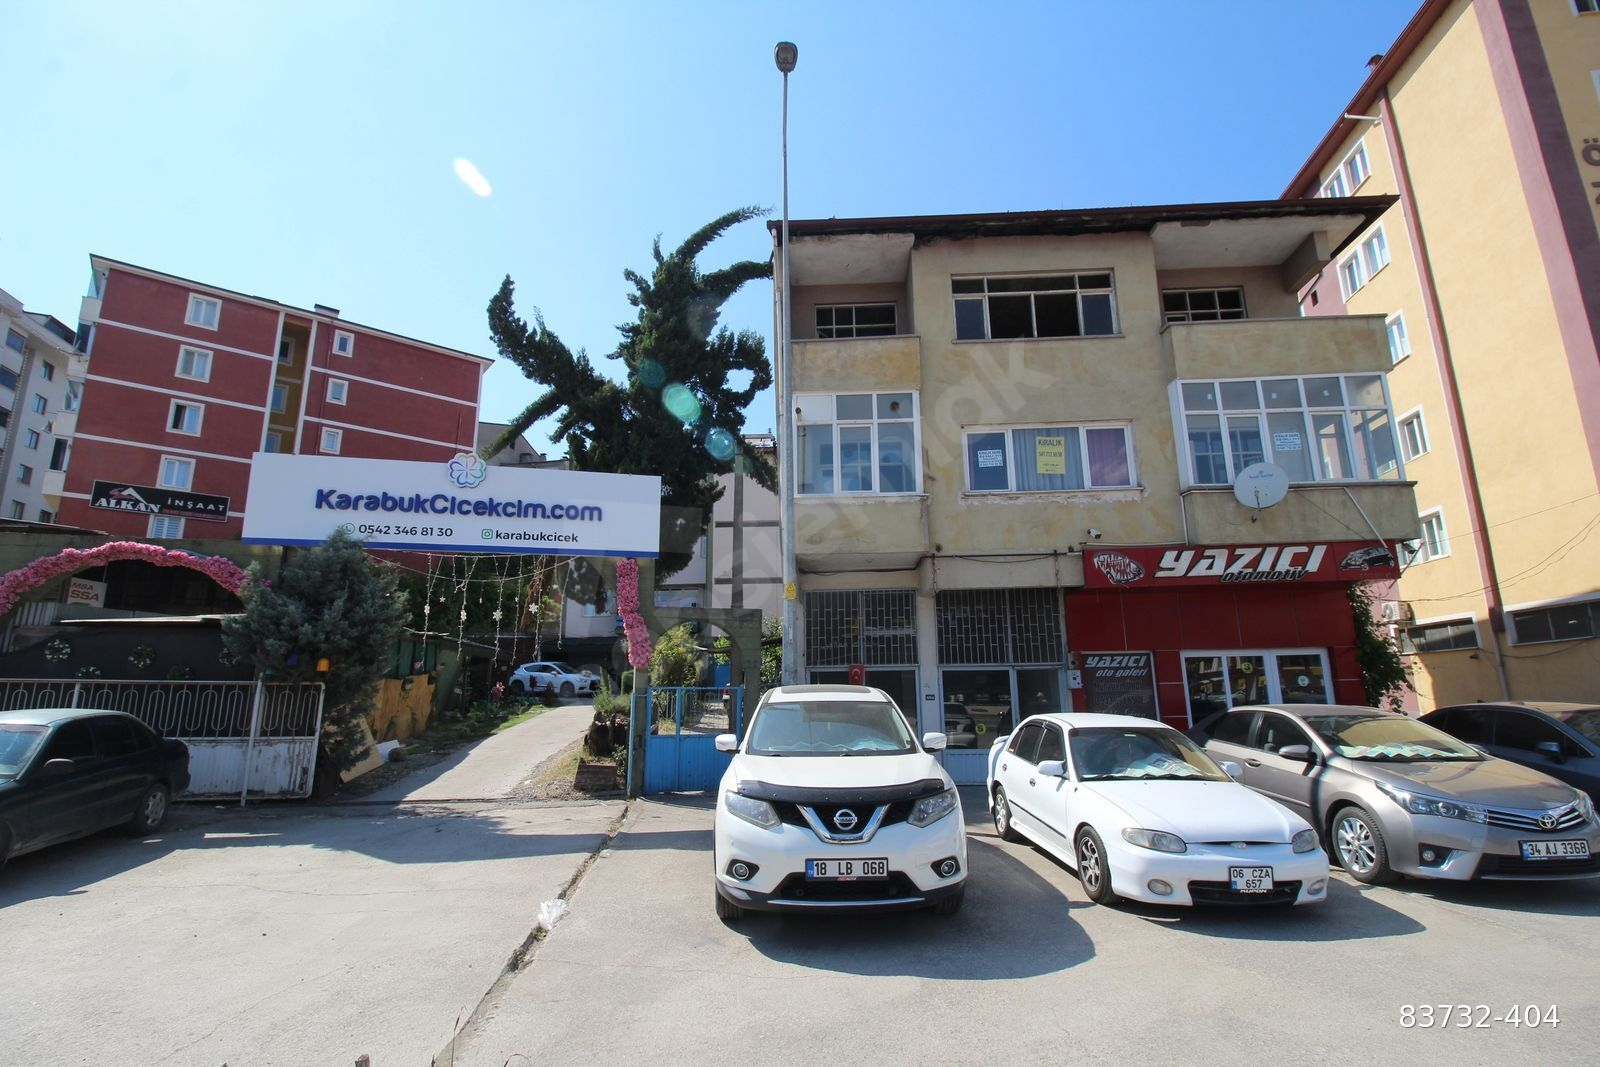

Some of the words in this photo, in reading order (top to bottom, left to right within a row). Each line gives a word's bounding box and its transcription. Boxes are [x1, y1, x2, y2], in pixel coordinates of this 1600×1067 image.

[95, 497, 160, 513] ALKAN
[358, 524, 390, 535] 0542
[393, 526, 418, 536] 346
[420, 527, 434, 537] 81
[437, 528, 453, 537] 30
[495, 530, 579, 543] karabukcicek
[1154, 544, 1328, 578] YAZICI
[1220, 569, 1309, 582] otomotiv
[1084, 655, 1148, 668] YAZICI
[1095, 669, 1112, 677] oto
[1115, 667, 1149, 678] galeri
[1528, 843, 1541, 856] 34
[1546, 843, 1558, 855] AJ
[1561, 842, 1587, 854] 3368
[814, 862, 827, 876] 18
[838, 862, 853, 875] LB
[862, 861, 885, 876] 068
[1232, 869, 1244, 878] 06
[1251, 869, 1271, 878] CZA
[1245, 879, 1262, 889] 657
